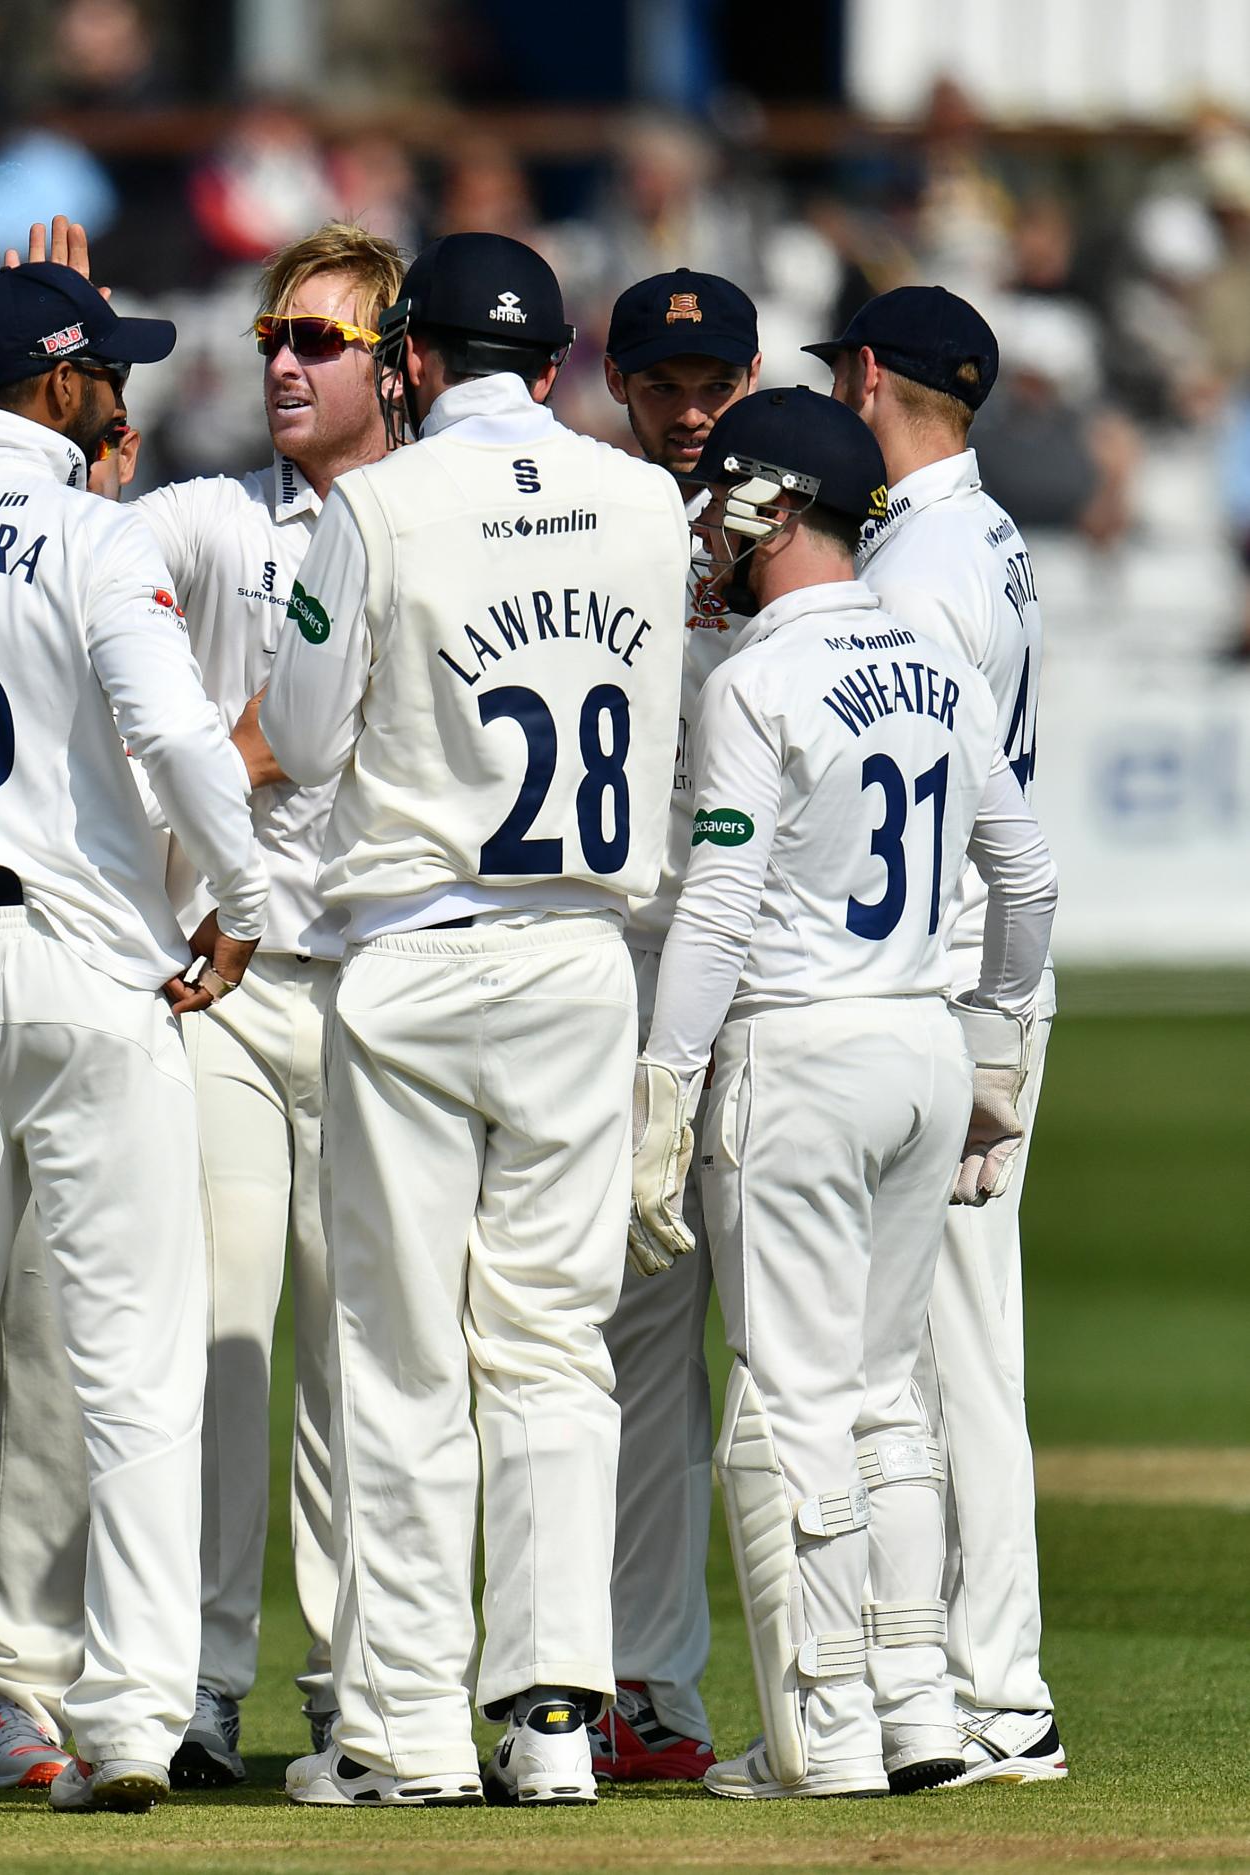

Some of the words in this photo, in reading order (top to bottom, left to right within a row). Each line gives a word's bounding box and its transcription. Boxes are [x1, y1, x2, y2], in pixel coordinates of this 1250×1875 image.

[489, 309, 528, 324] SHREY
[481, 520, 514, 539] MS
[437, 588, 652, 687] LAWRENCE
[823, 636, 853, 651] MS
[822, 661, 961, 738] WHEATER
[477, 683, 631, 876] 28
[845, 752, 950, 941] 31
[546, 1710, 571, 1724] NIKE
